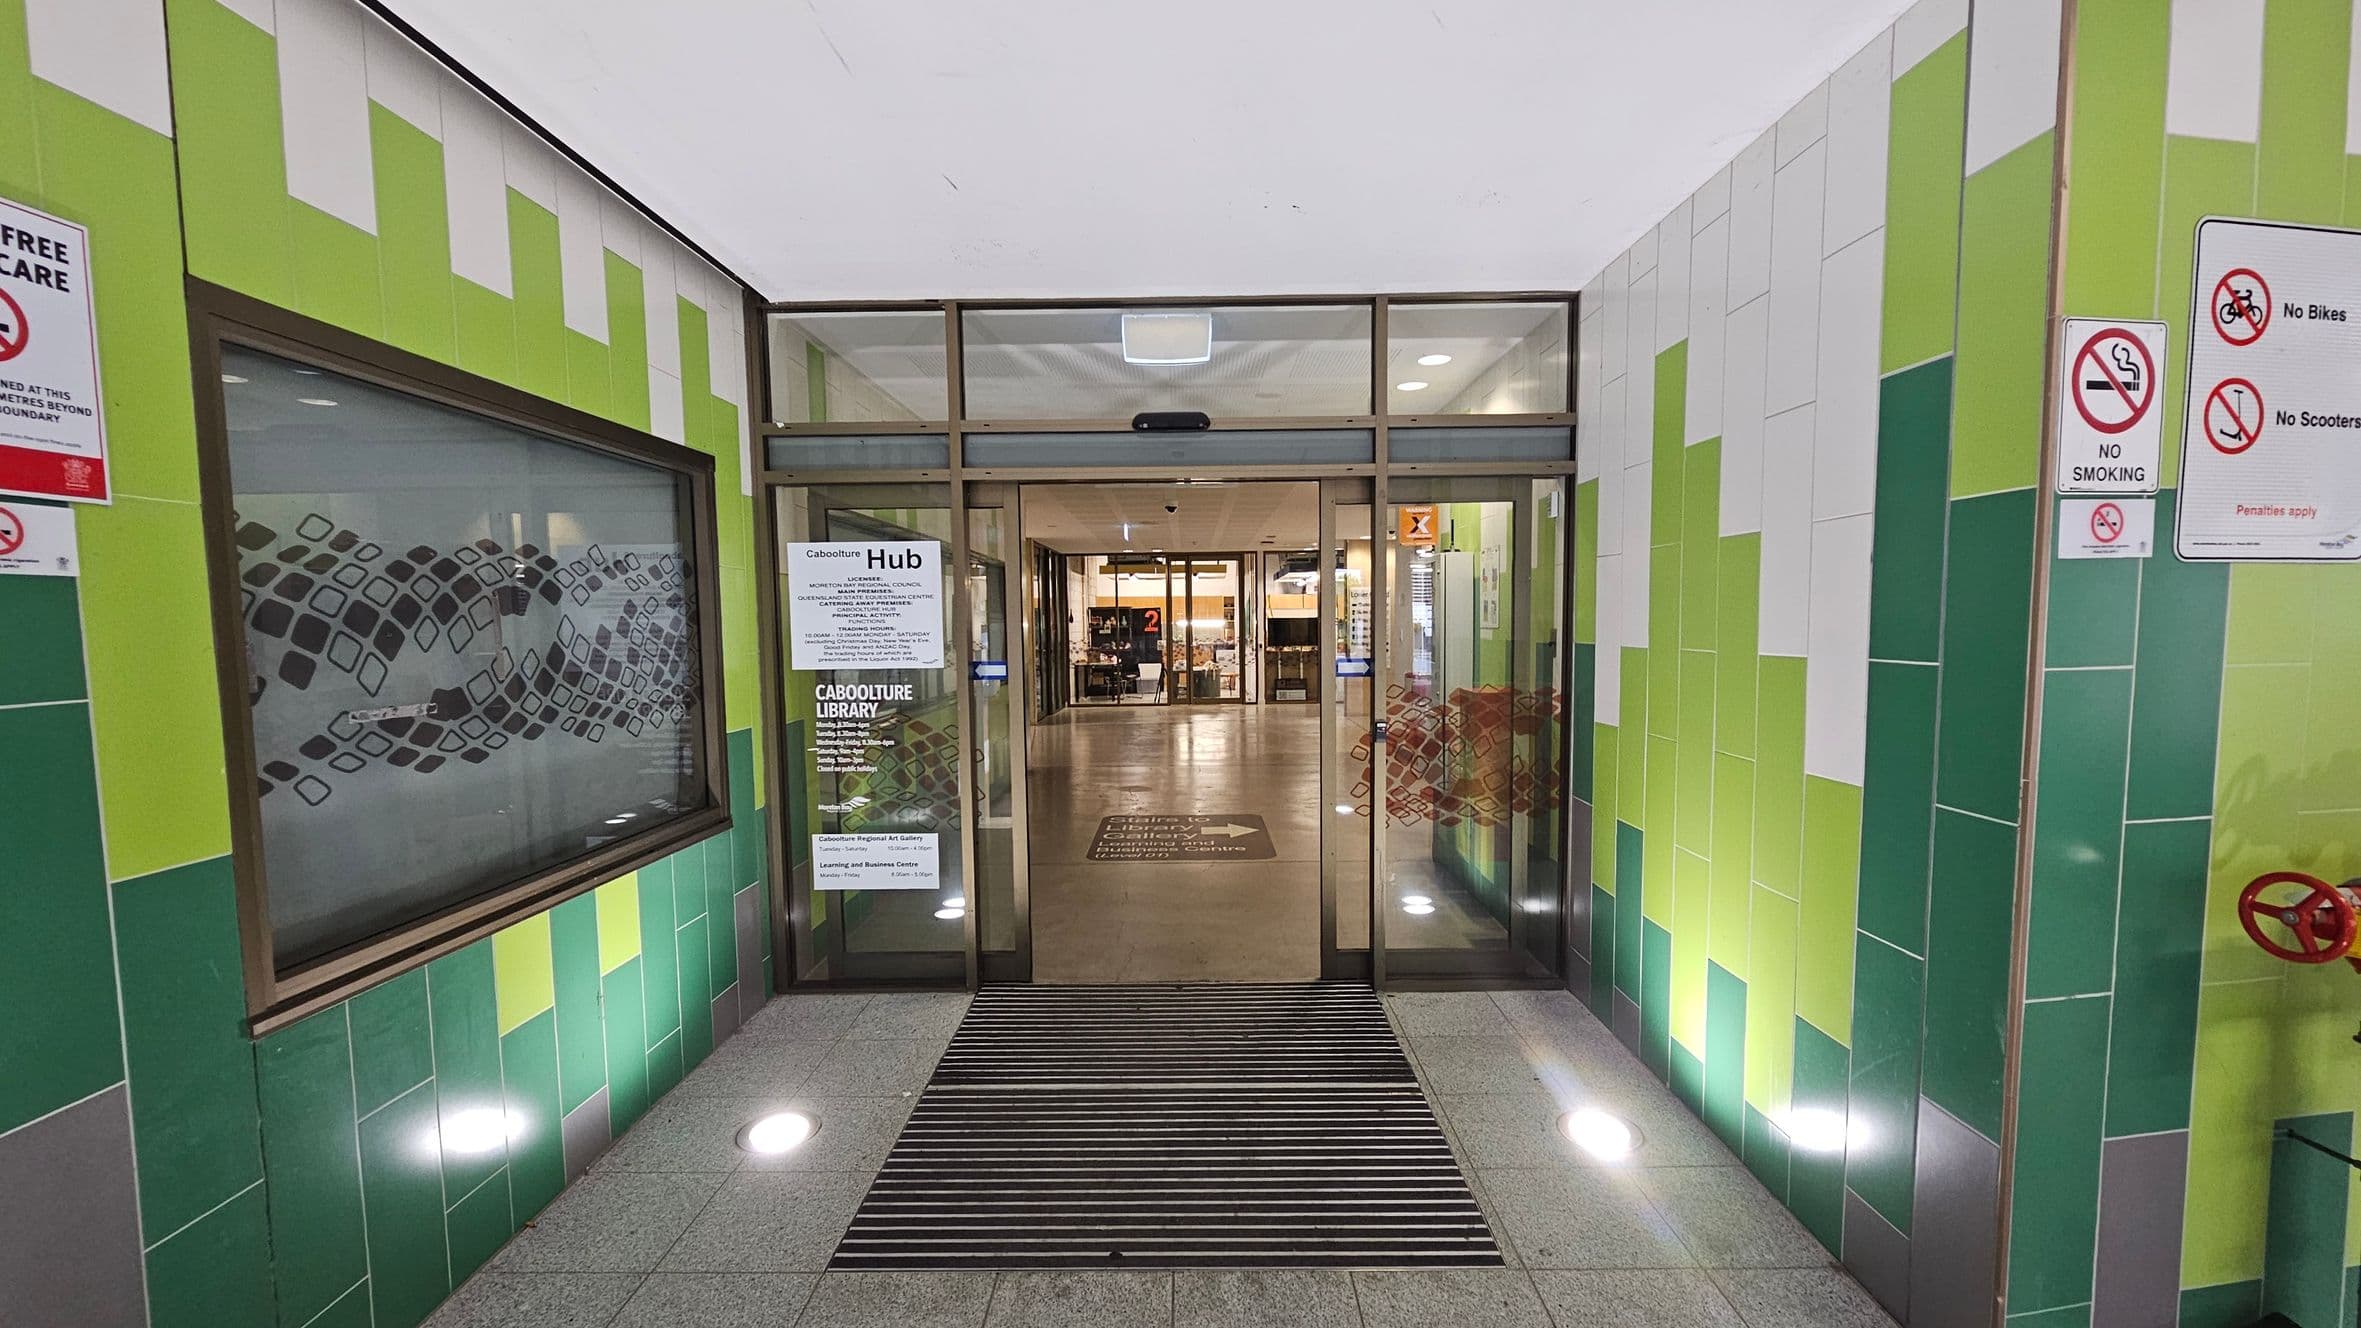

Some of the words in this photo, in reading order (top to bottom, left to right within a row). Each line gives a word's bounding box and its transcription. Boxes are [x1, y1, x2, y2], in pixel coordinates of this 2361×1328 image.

[1, 223, 70, 265] FREE
[2283, 303, 2304, 318] No
[2308, 304, 2347, 322] Bikes
[28, 384, 42, 395] AT
[44, 387, 71, 401] THIS
[47, 401, 92, 417] BEYOND
[2276, 410, 2296, 426] No
[2300, 411, 2361, 429] Scooters
[2099, 444, 2121, 459] NO
[2072, 467, 2145, 482] SMOKING
[2236, 505, 2286, 517] Penalties
[2288, 507, 2318, 520] apply
[806, 549, 861, 558] Caboolture
[867, 548, 922, 570] Hub
[815, 684, 913, 701] CABOOLTURE
[816, 702, 879, 718] LIBRARY
[1103, 832, 1198, 840] Gallery
[1106, 824, 1194, 832] Library
